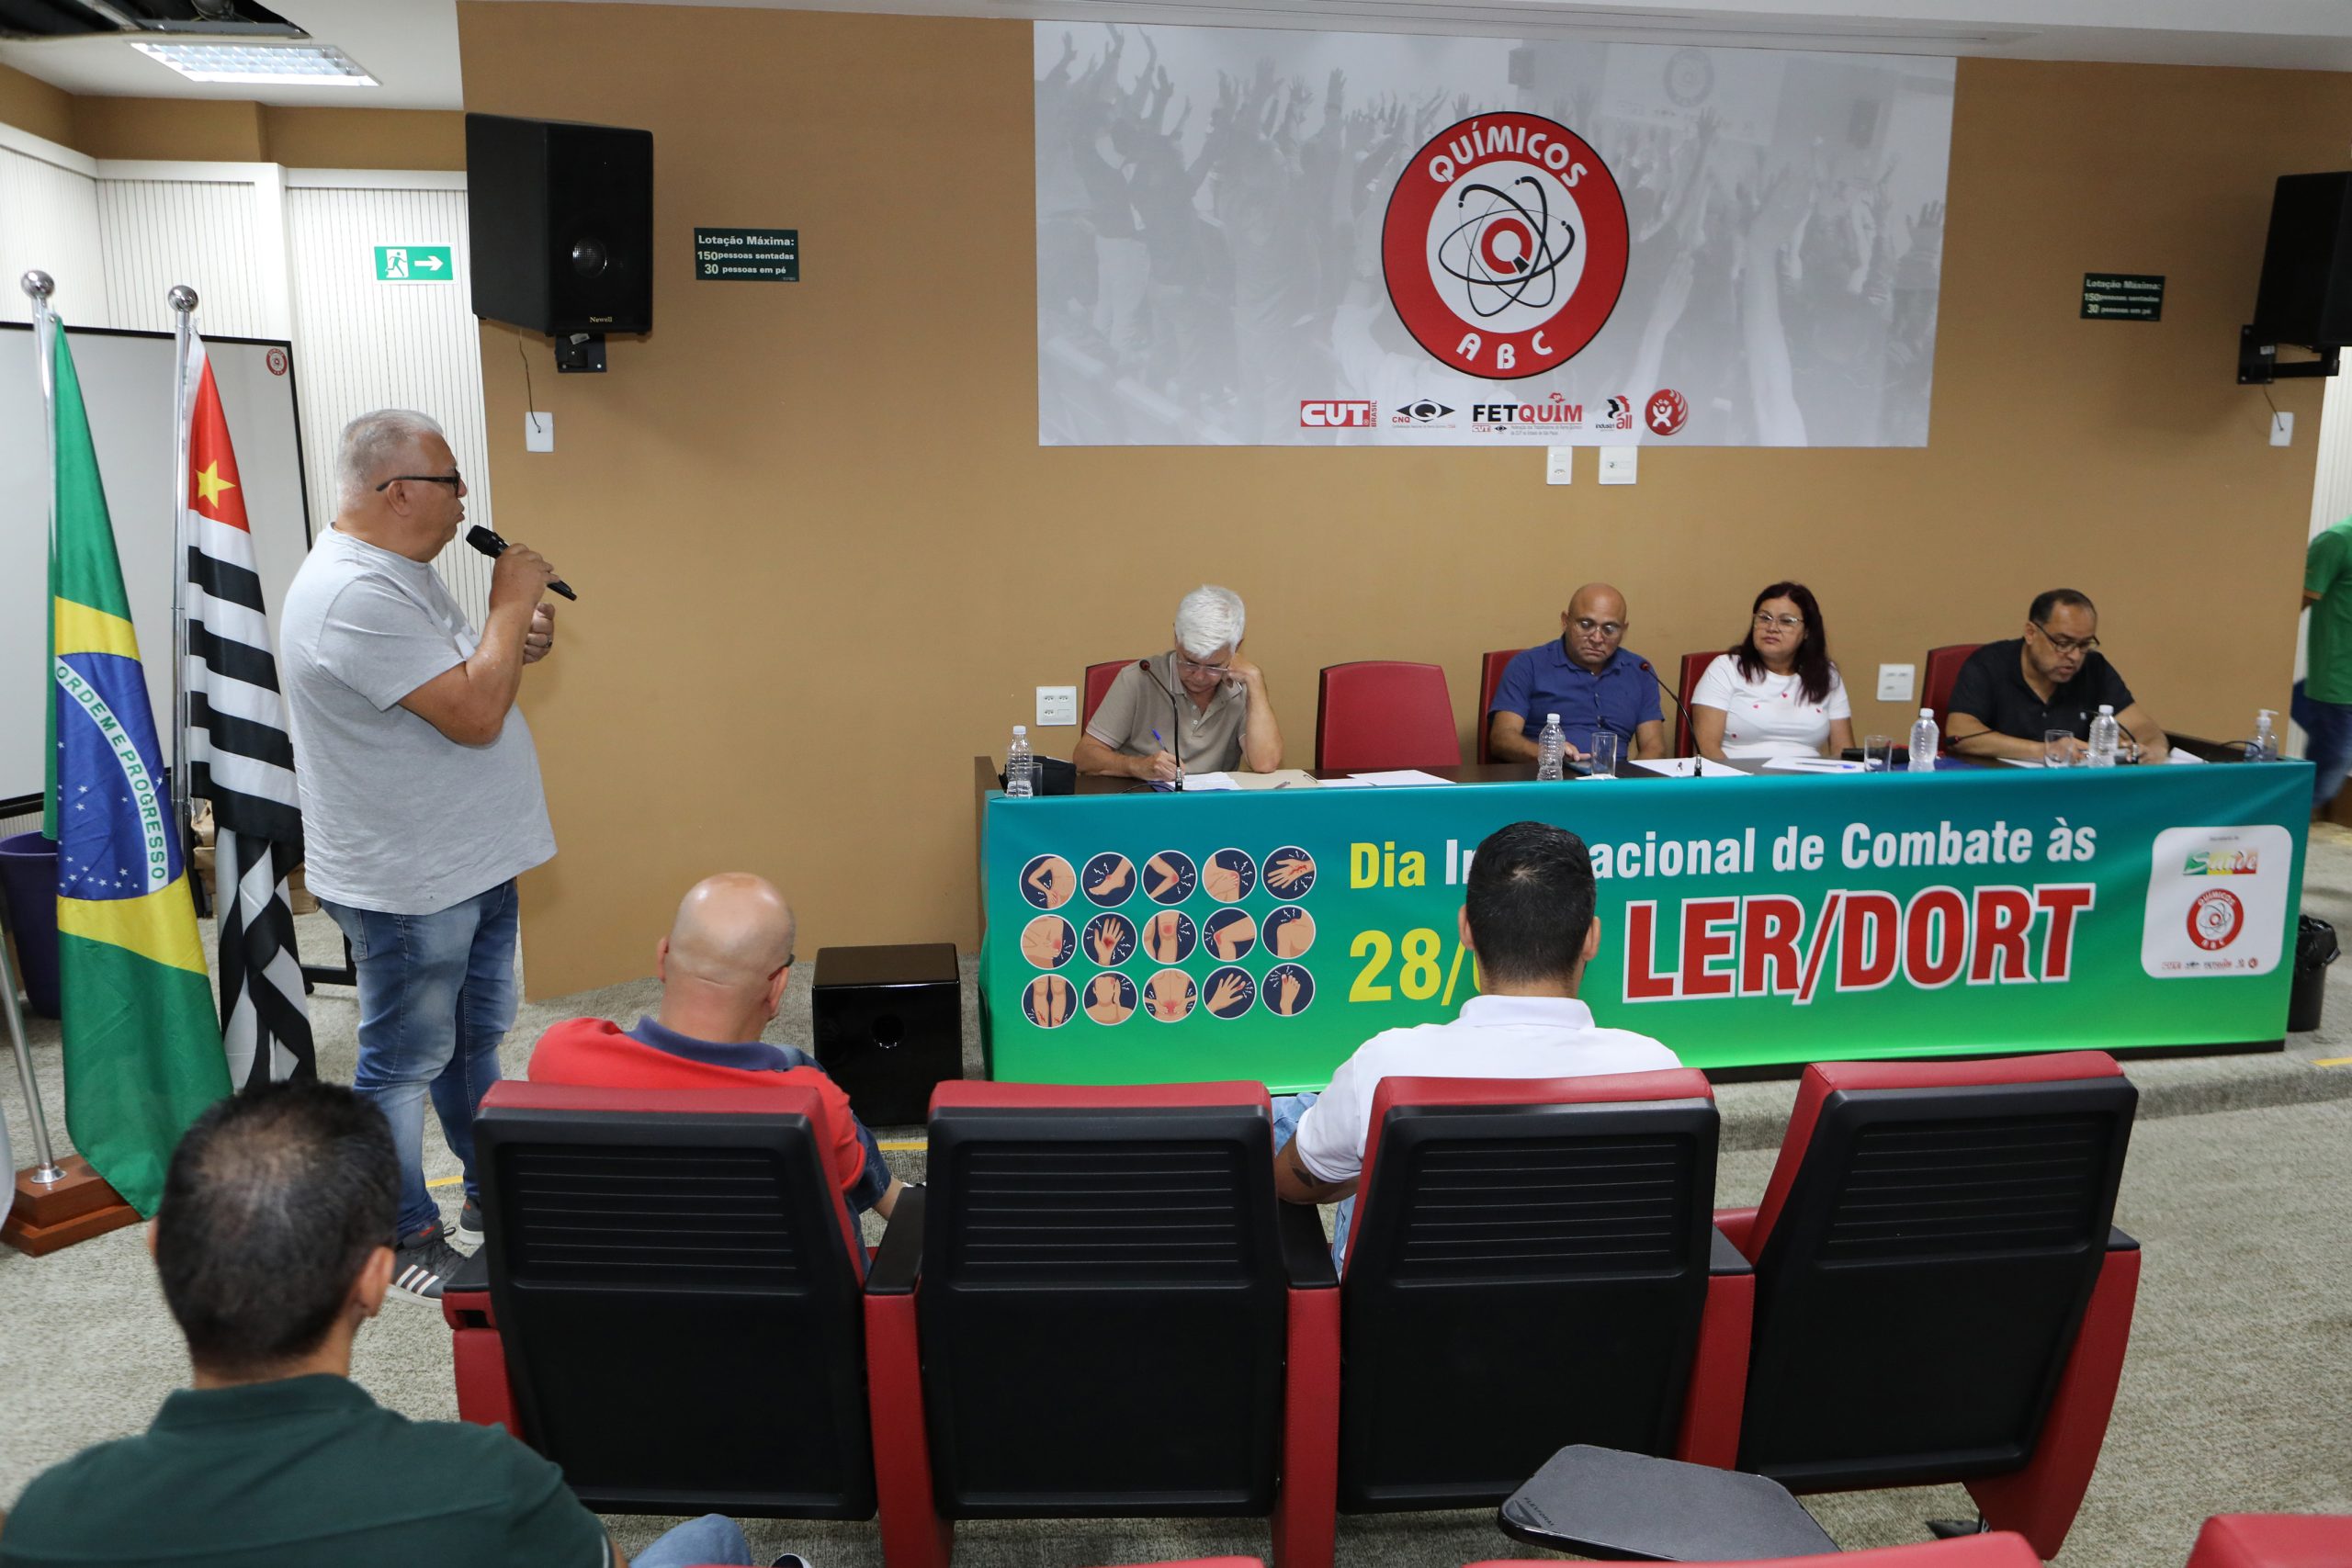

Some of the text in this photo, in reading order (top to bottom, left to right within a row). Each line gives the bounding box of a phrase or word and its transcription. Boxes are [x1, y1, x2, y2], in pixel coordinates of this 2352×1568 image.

[1429, 121, 1589, 187] QUÍMICOS
[698, 235, 794, 246] Lotação Máxima:
[704, 264, 718, 274] 30
[775, 266, 786, 275] pé
[56, 665, 166, 880] ORDEM E PROGRESSO
[1350, 840, 1426, 889] Dia
[1772, 826, 1825, 872] de
[1841, 820, 2033, 869] Combate
[2046, 817, 2097, 863] às
[1623, 883, 2097, 1005] LER/DORT
